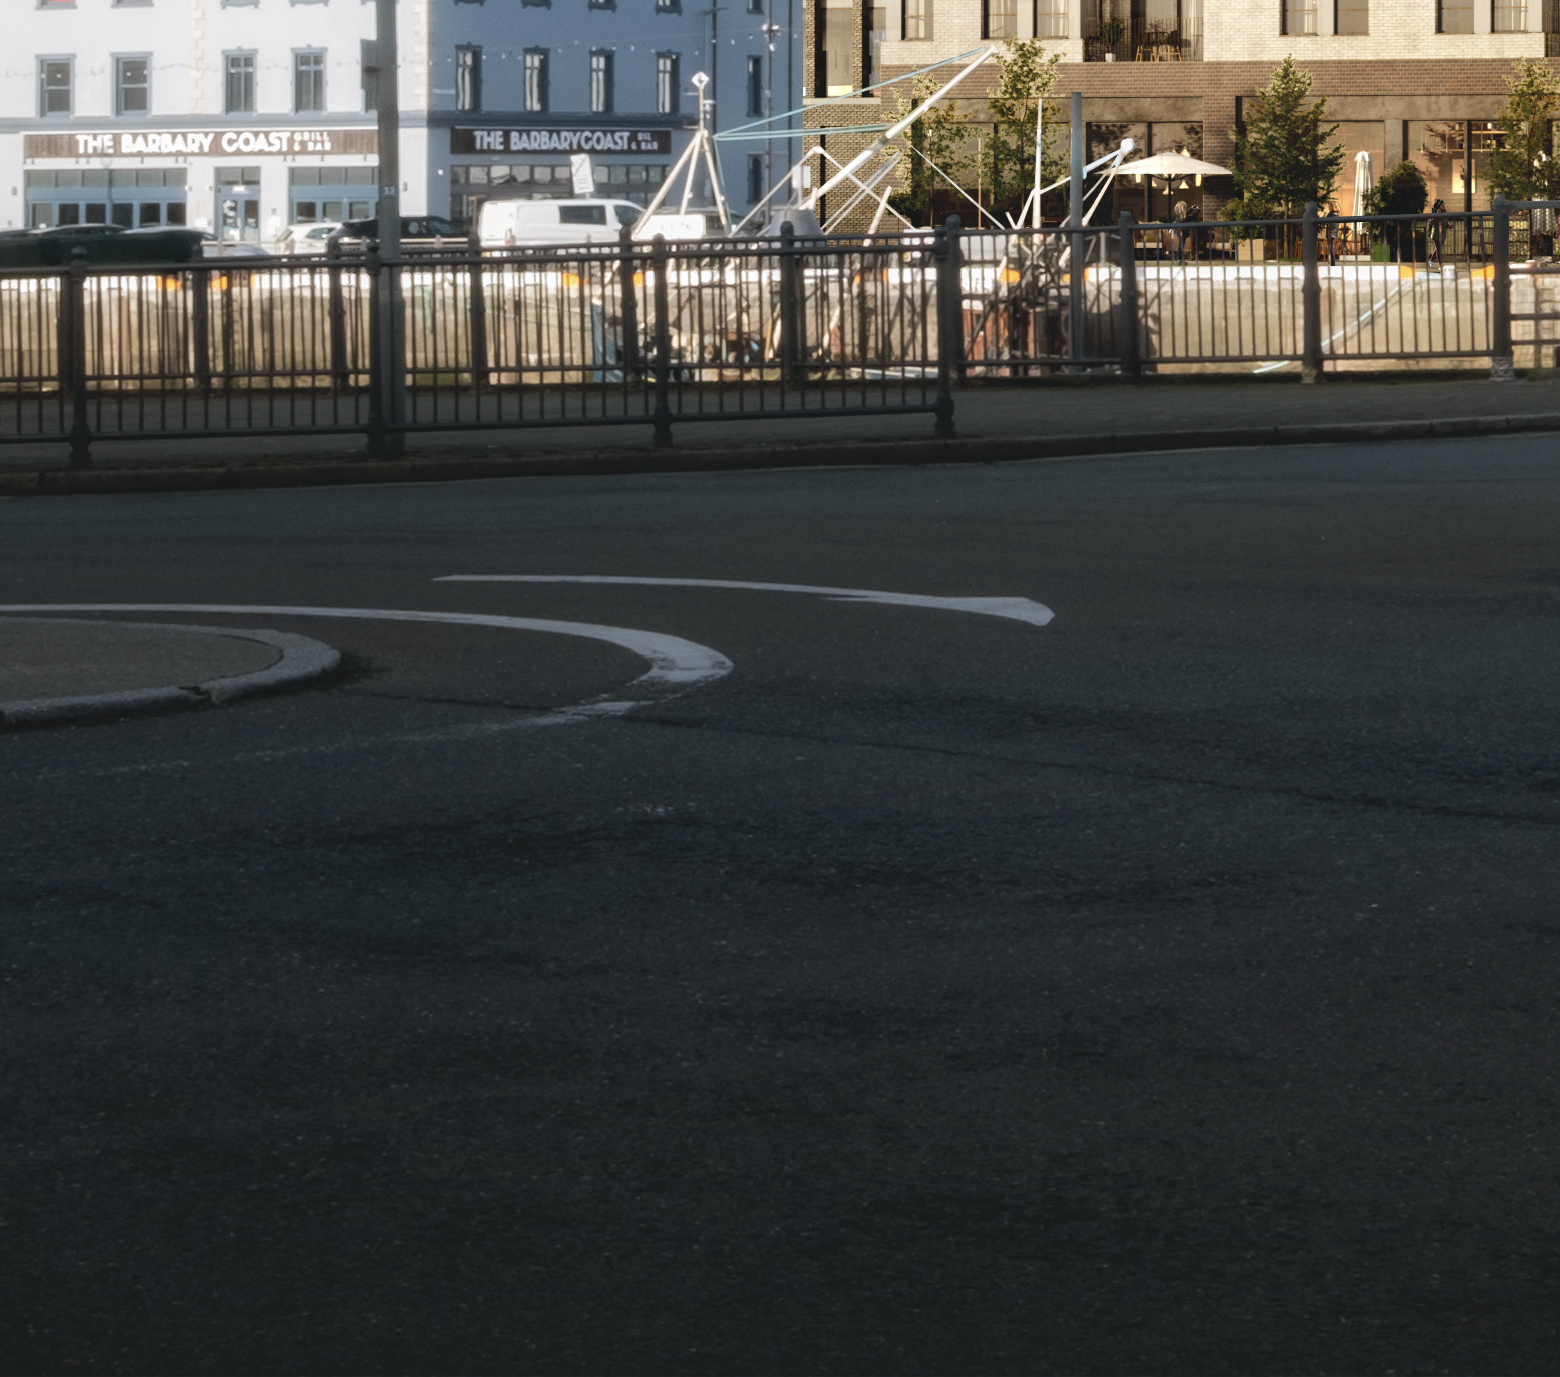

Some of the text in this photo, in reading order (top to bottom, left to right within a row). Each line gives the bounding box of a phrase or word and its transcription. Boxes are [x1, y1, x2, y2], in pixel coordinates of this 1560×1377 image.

[75, 131, 291, 154] THE BARBARY COAST
[473, 130, 504, 151] THE
